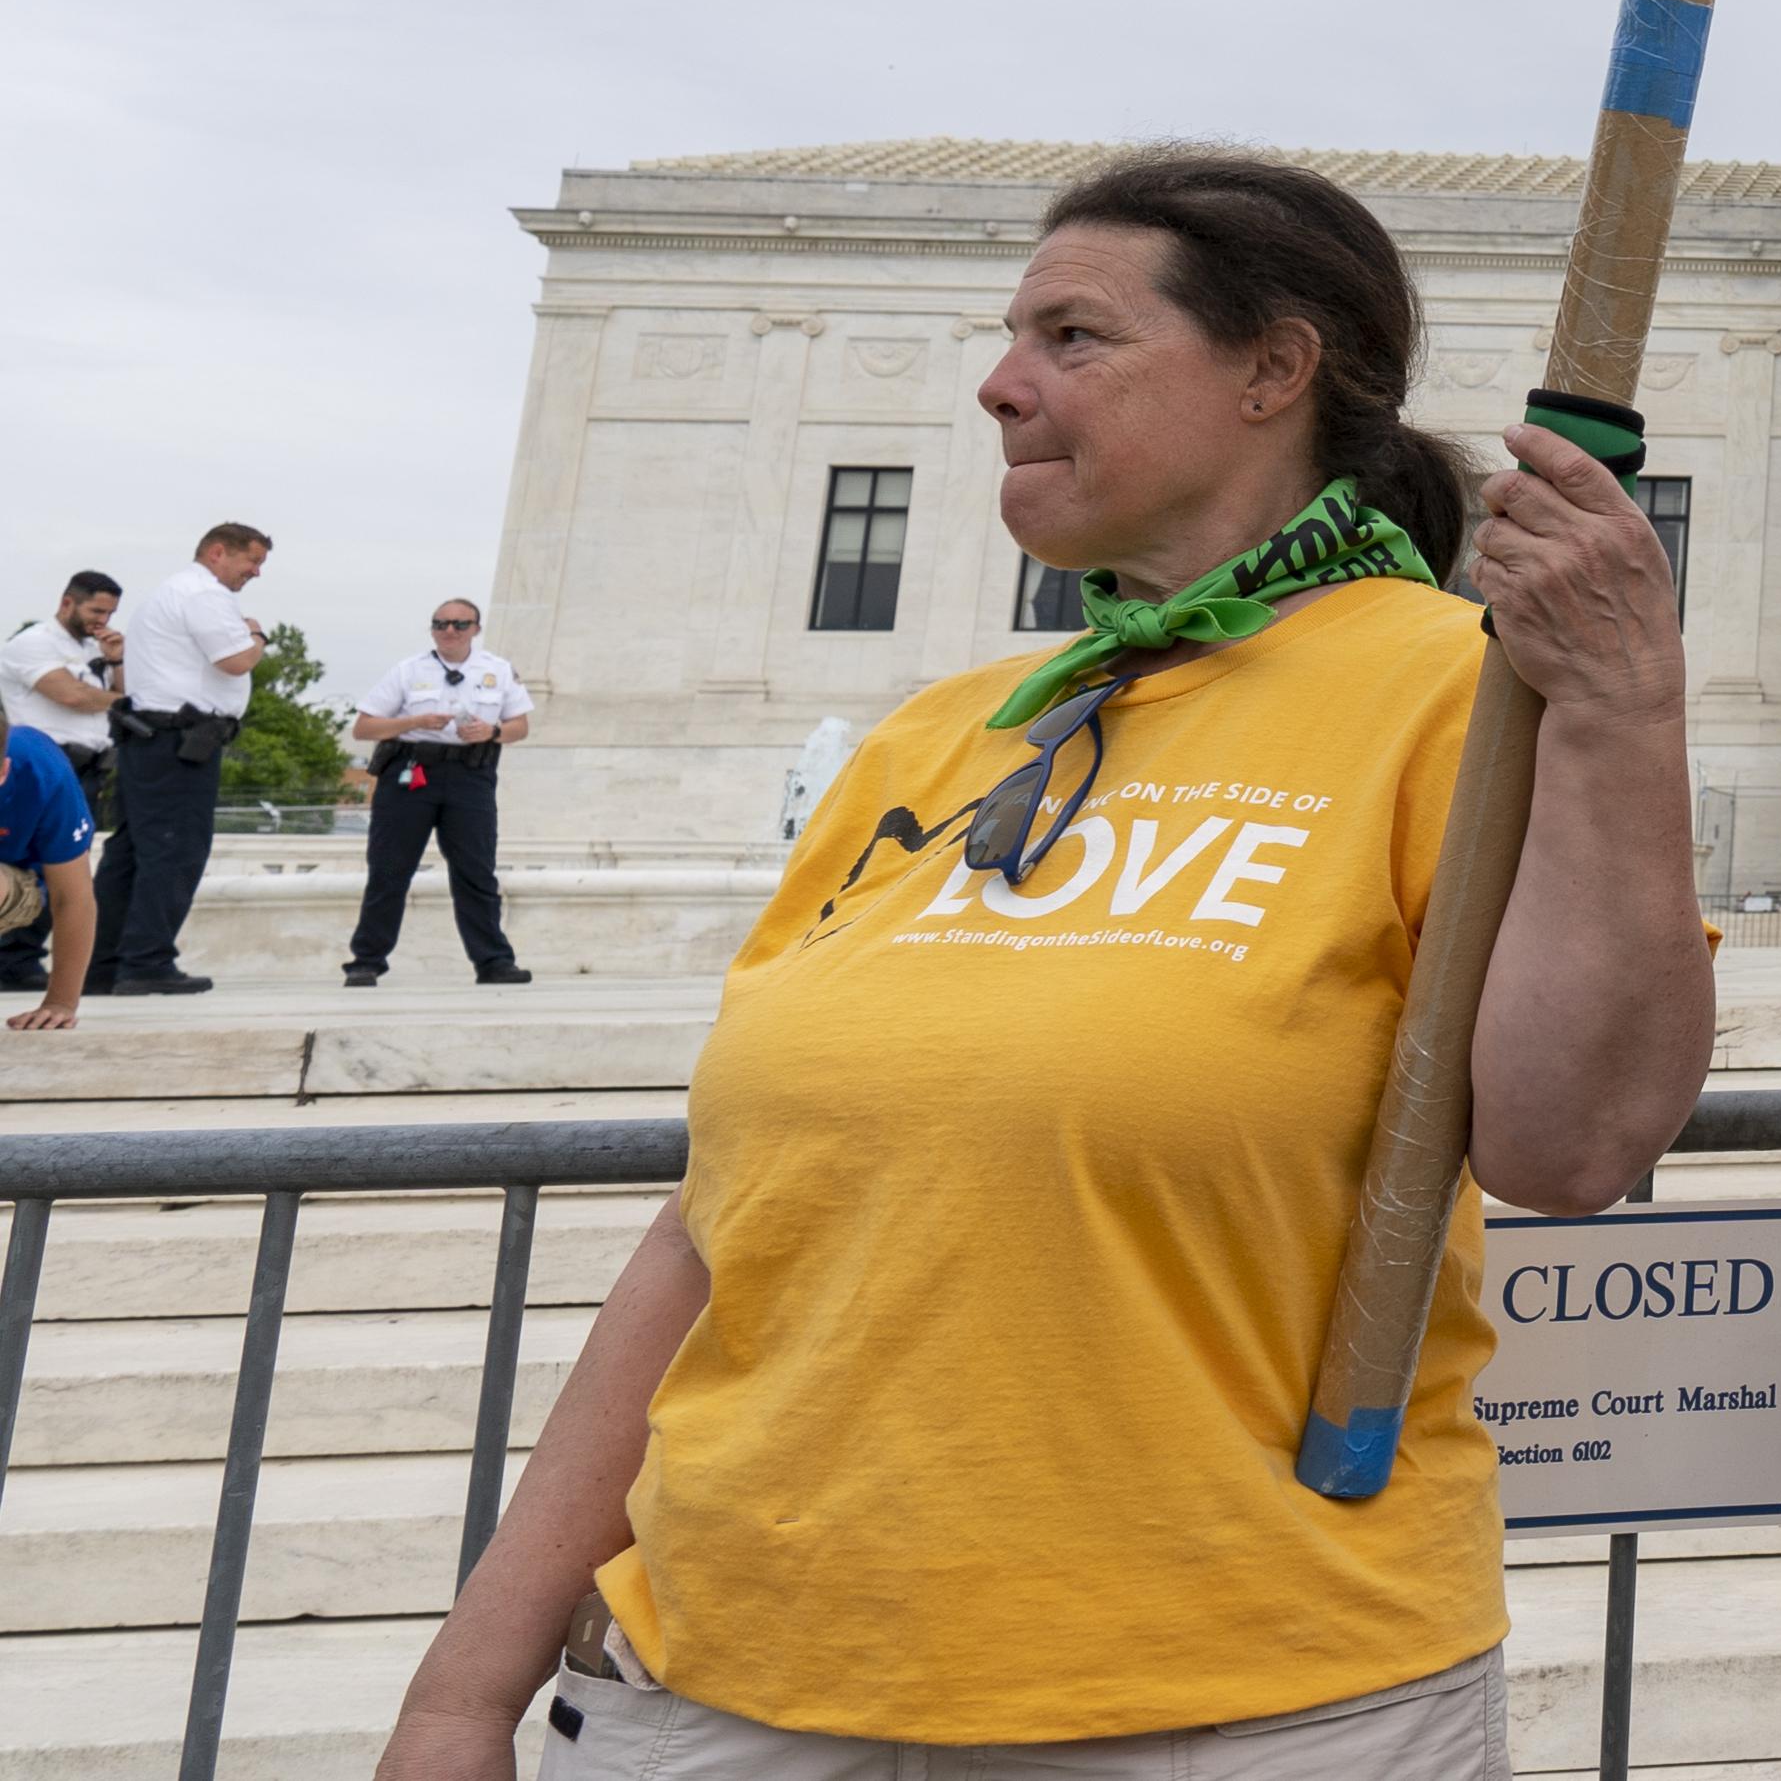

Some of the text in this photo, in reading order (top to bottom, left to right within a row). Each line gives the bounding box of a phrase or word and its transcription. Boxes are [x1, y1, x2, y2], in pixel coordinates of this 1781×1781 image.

[1120, 782, 1165, 801] ON
[1173, 782, 1220, 802] THE
[1223, 784, 1287, 811] SIDE
[1292, 792, 1332, 813] OF
[916, 815, 1310, 926] LOVE
[1502, 1259, 1774, 1323] CLOSED
[1474, 1383, 1777, 1425] Supreme Court Marshal
[1572, 1440, 1611, 1461] 6102
